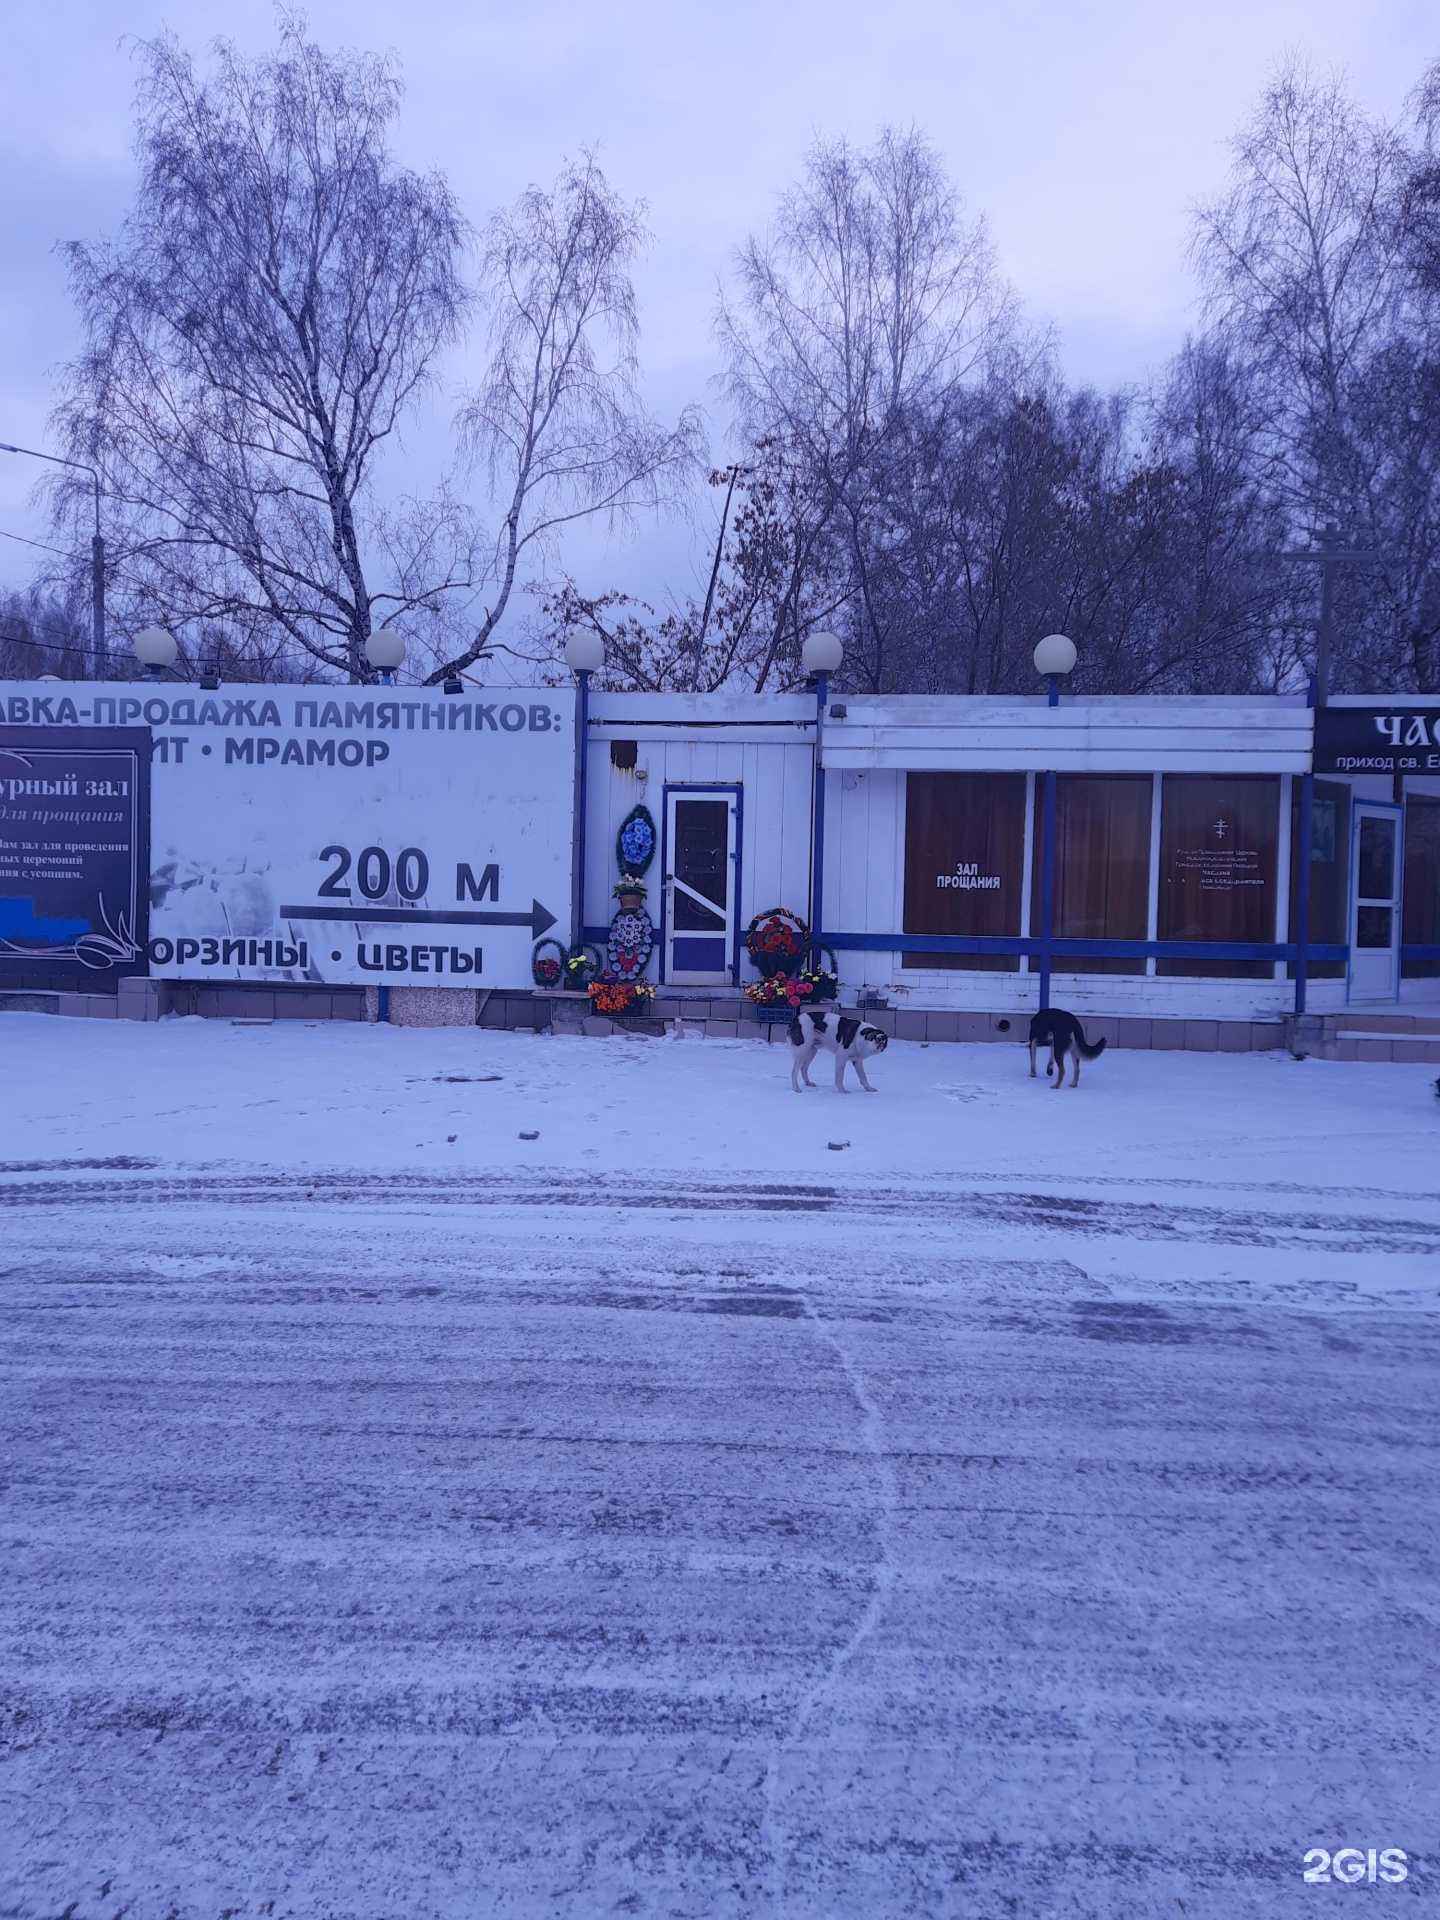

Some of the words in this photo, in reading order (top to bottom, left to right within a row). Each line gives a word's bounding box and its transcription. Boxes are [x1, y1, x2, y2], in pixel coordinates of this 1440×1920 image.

[0, 696, 281, 727] ВКА-ПРОДАЖА
[294, 700, 562, 733] ПАМЯТНИКОВ:
[1373, 715, 1440, 746] ЧА
[225, 738, 390, 767] МРАМОР
[1337, 757, 1394, 770] приход
[1399, 757, 1421, 768] св.
[1427, 754, 1440, 768] Е
[86, 780, 129, 797] зал
[32, 809, 124, 826] прощания
[318, 844, 430, 902] 200
[957, 863, 978, 875] ЗАЛ
[936, 875, 1001, 890] ПРОЩАНИЯ
[357, 943, 483, 974] ЦВЕТЫ
